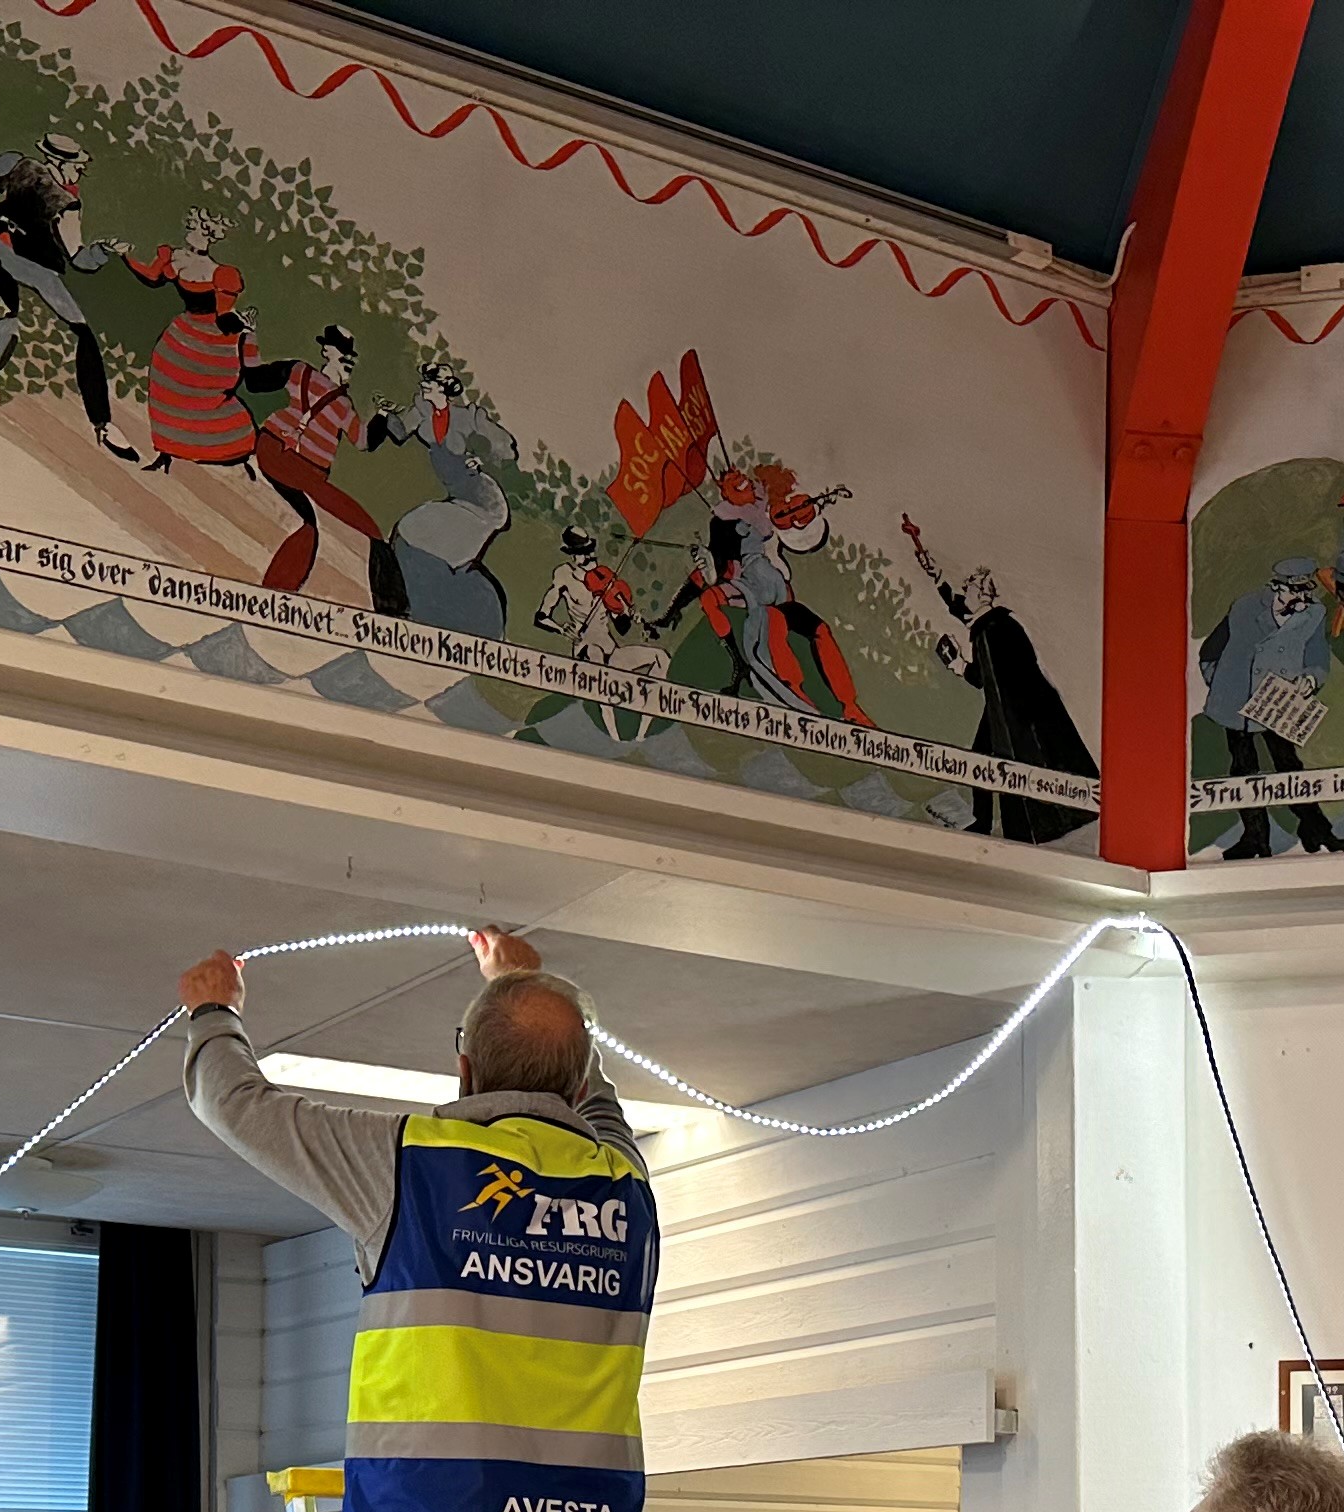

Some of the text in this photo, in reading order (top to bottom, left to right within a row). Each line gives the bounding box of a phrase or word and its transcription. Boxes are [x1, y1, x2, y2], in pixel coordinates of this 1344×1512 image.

[38, 543, 75, 582] sig
[81, 551, 134, 586] över
[353, 613, 434, 658] Skalden
[570, 665, 633, 705] farliga
[659, 689, 686, 716] blir
[689, 690, 751, 729] Folkets
[1245, 776, 1324, 802] Thalias
[525, 1193, 628, 1243] FRG
[452, 1228, 628, 1263] FRIVILLIGA RESURSGRUPPEN
[460, 1251, 621, 1296] ANSVARIG
